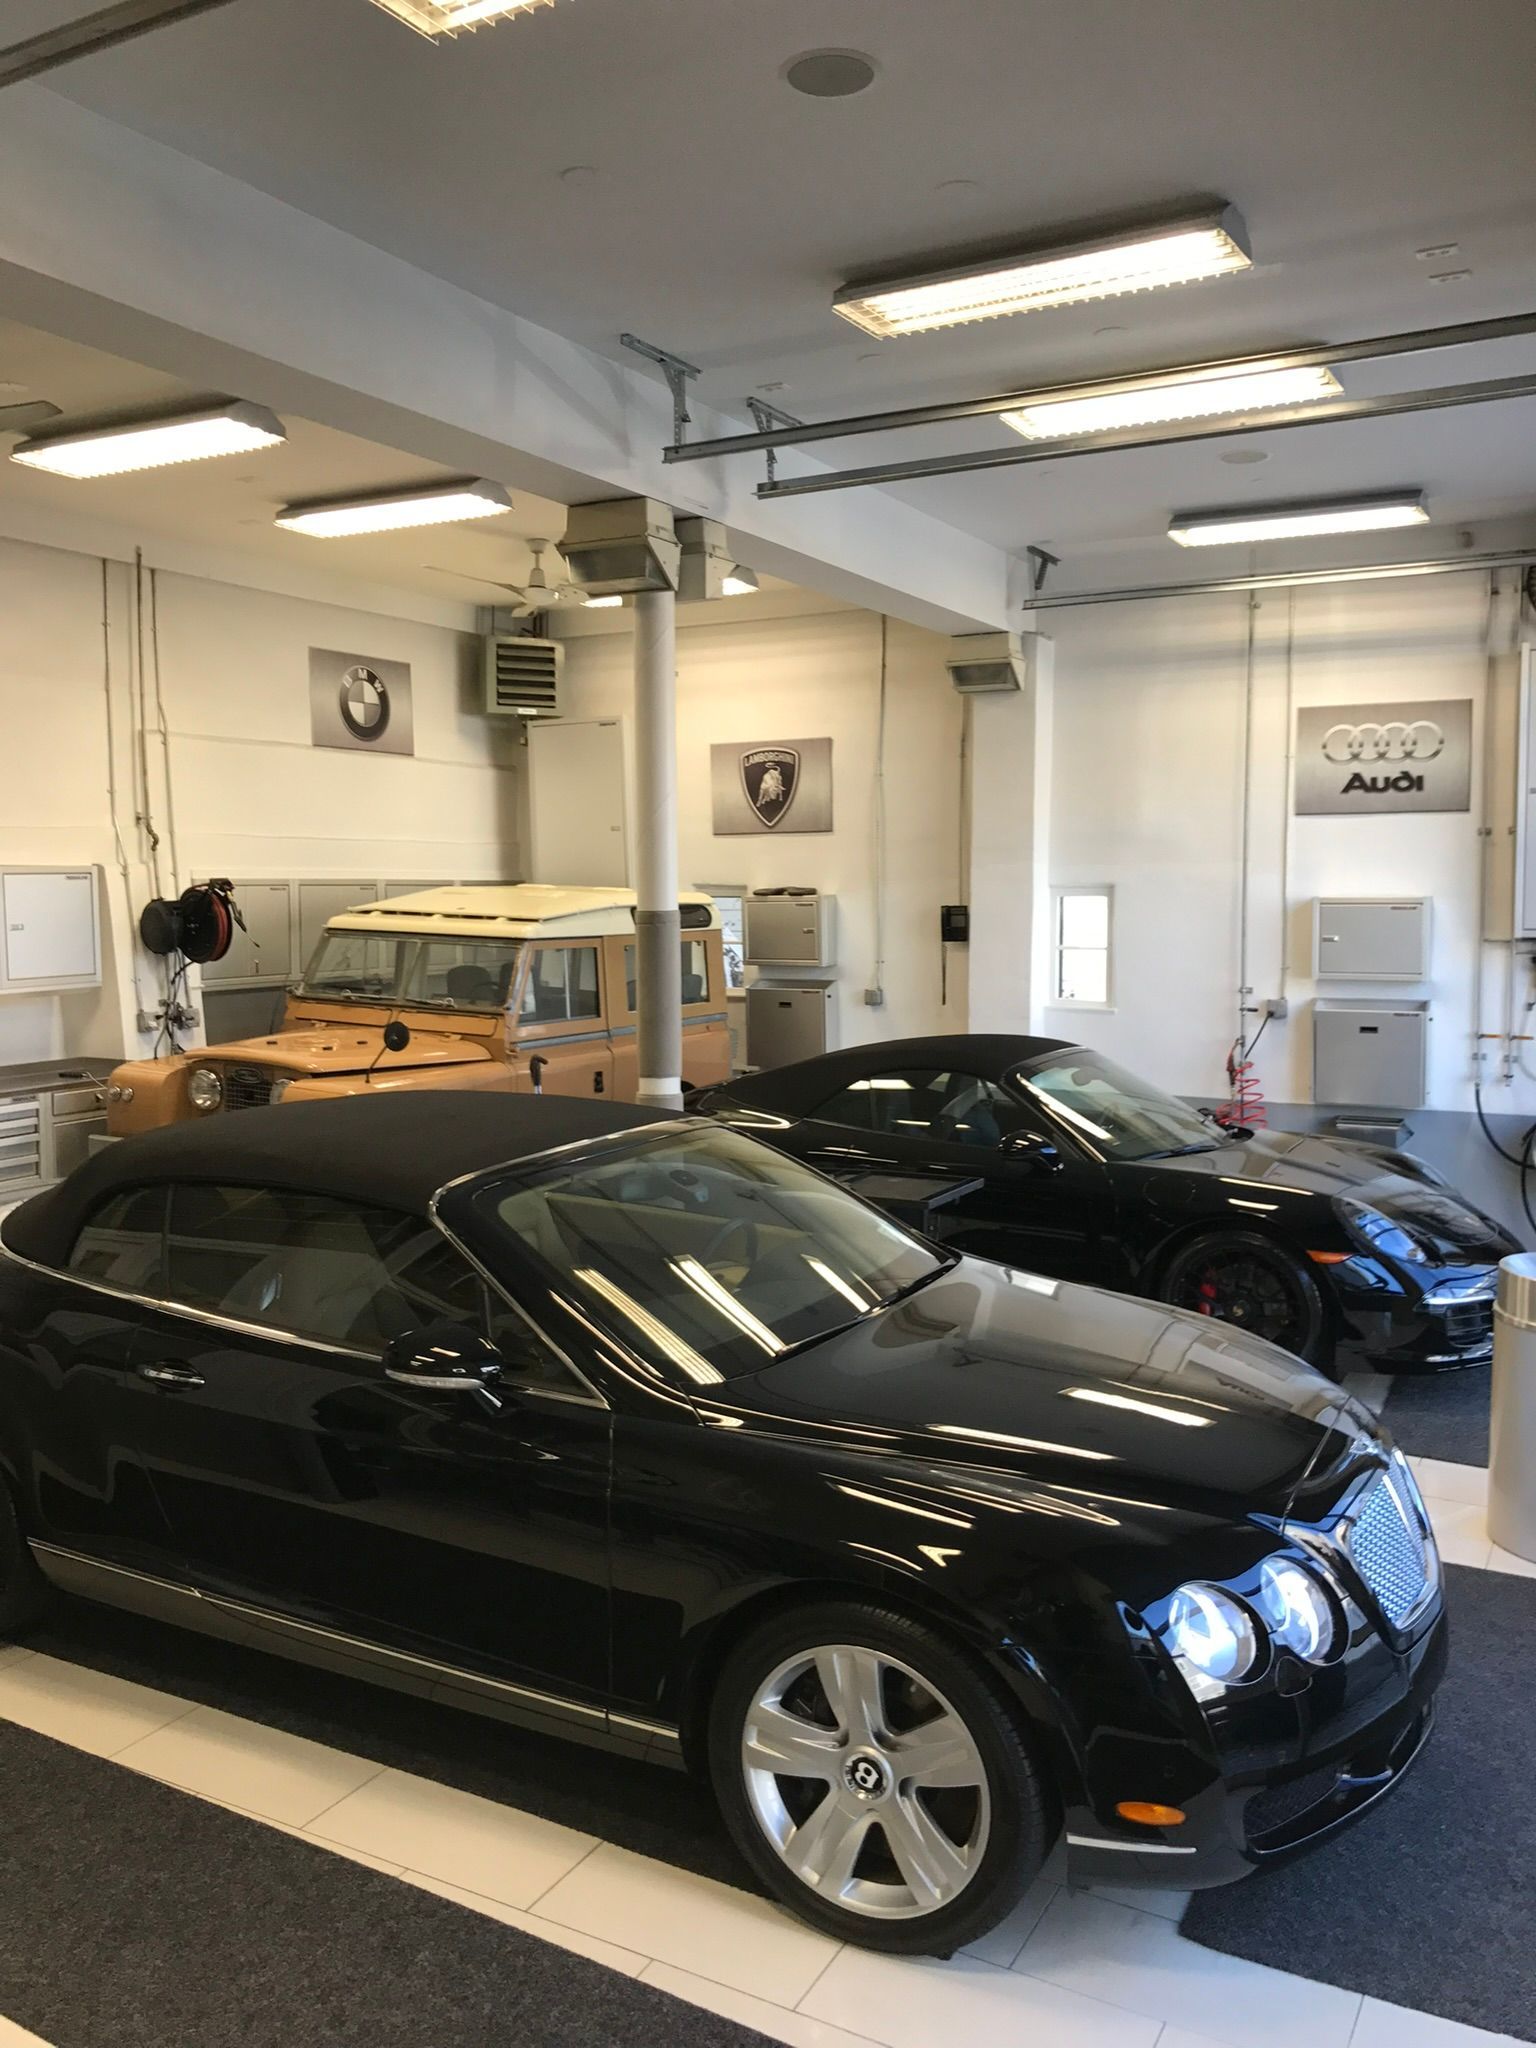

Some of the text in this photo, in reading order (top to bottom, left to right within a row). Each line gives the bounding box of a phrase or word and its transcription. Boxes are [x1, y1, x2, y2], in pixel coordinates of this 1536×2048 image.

[342, 668, 385, 693] BMW
[744, 751, 795, 767] LAMBORGHINI
[1340, 771, 1424, 794] Audi
